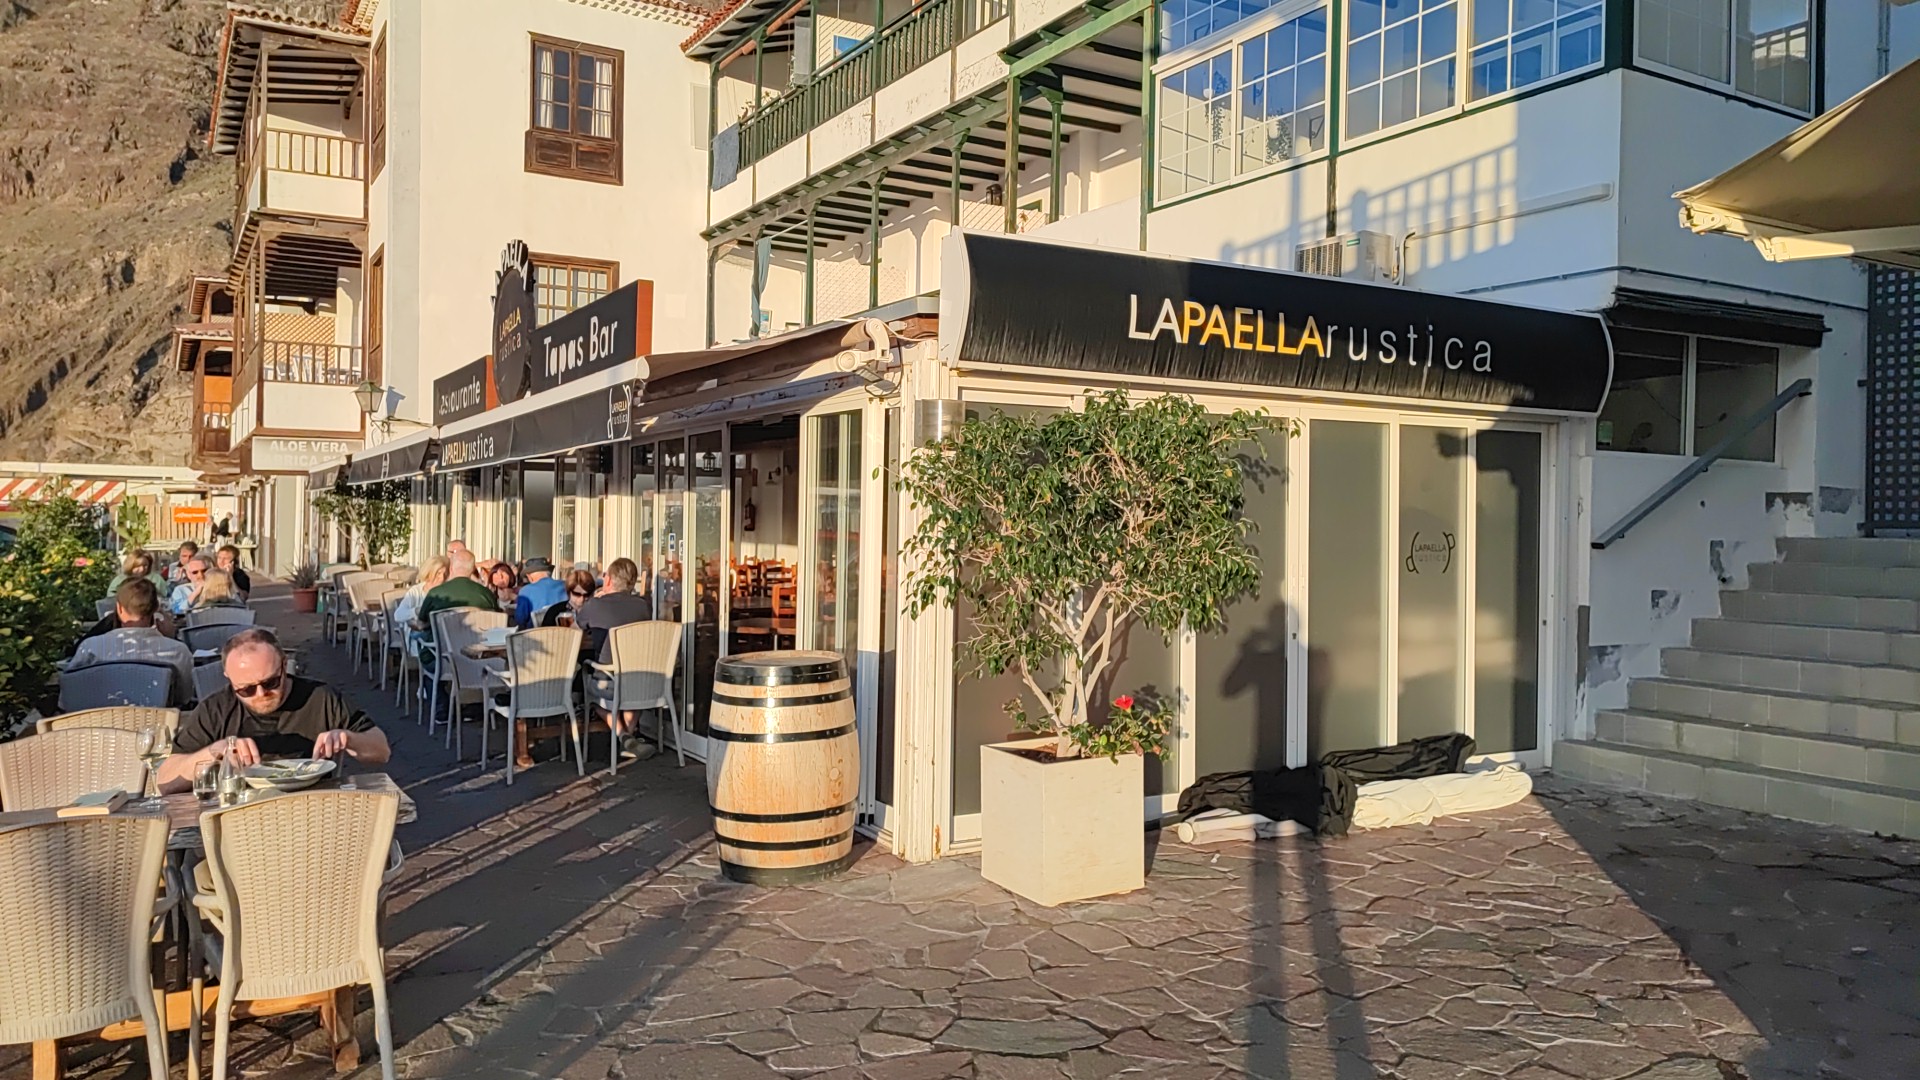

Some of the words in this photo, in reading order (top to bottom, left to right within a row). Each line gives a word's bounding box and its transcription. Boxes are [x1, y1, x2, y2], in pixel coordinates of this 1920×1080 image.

[543, 335, 584, 385] Tapas
[589, 315, 618, 362] Bar
[437, 374, 481, 416] estaurante
[270, 440, 307, 452] ALOE
[311, 441, 349, 453] VERA
[1414, 543, 1447, 552] LAPAELLA
